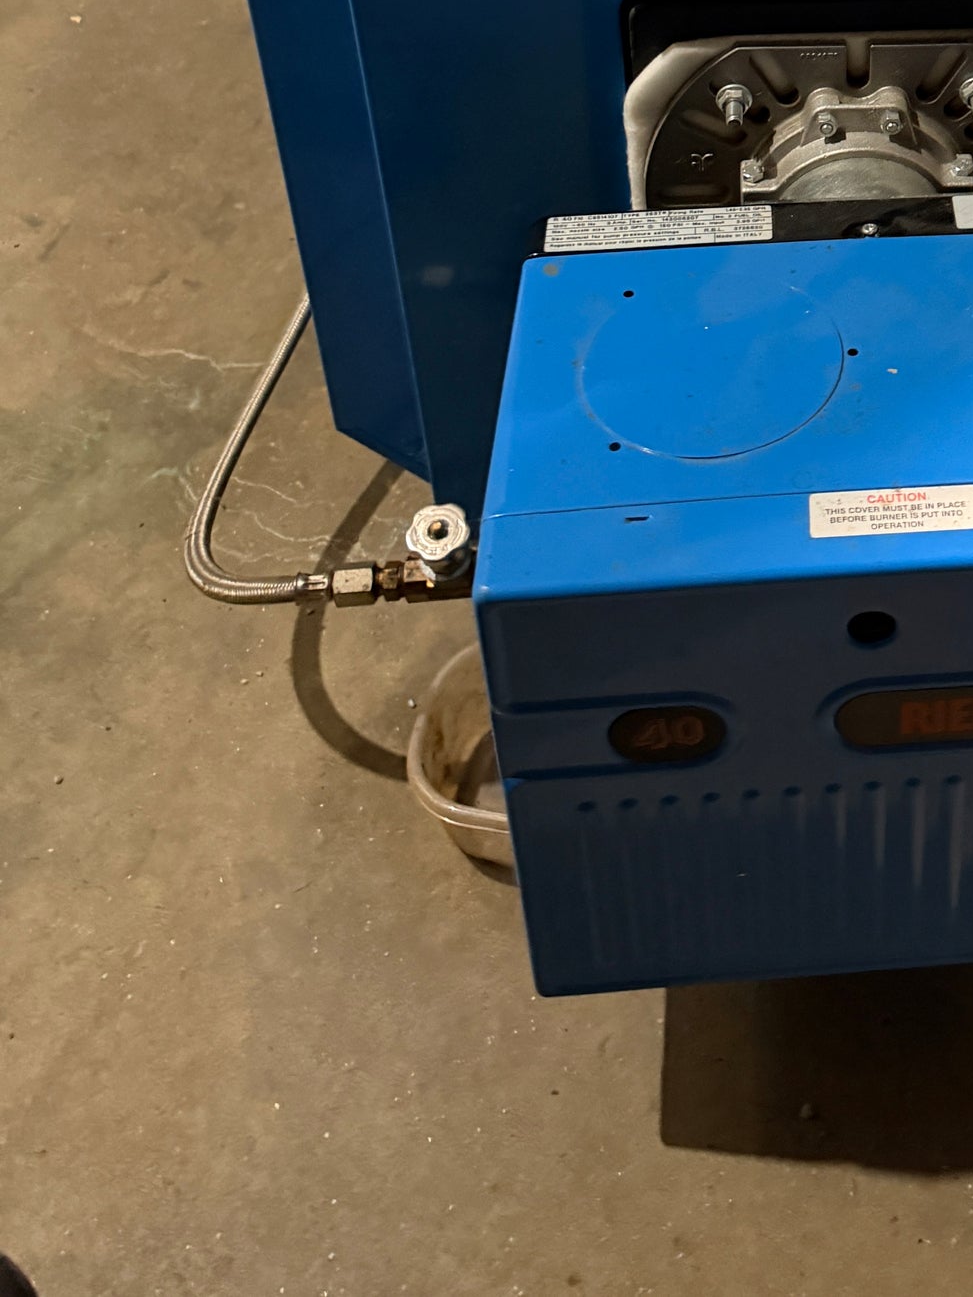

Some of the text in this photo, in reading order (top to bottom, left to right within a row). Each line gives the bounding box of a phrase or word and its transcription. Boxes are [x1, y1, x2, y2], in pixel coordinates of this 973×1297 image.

[867, 492, 927, 504] CAUTION
[849, 506, 880, 514] COVER
[882, 504, 909, 512] MUST
[937, 501, 966, 509] PLACE
[830, 515, 867, 524] BEFORE
[870, 513, 907, 521] BURNER
[942, 509, 963, 517] INTO
[871, 521, 924, 530] OPERATION
[634, 715, 705, 750] 40
